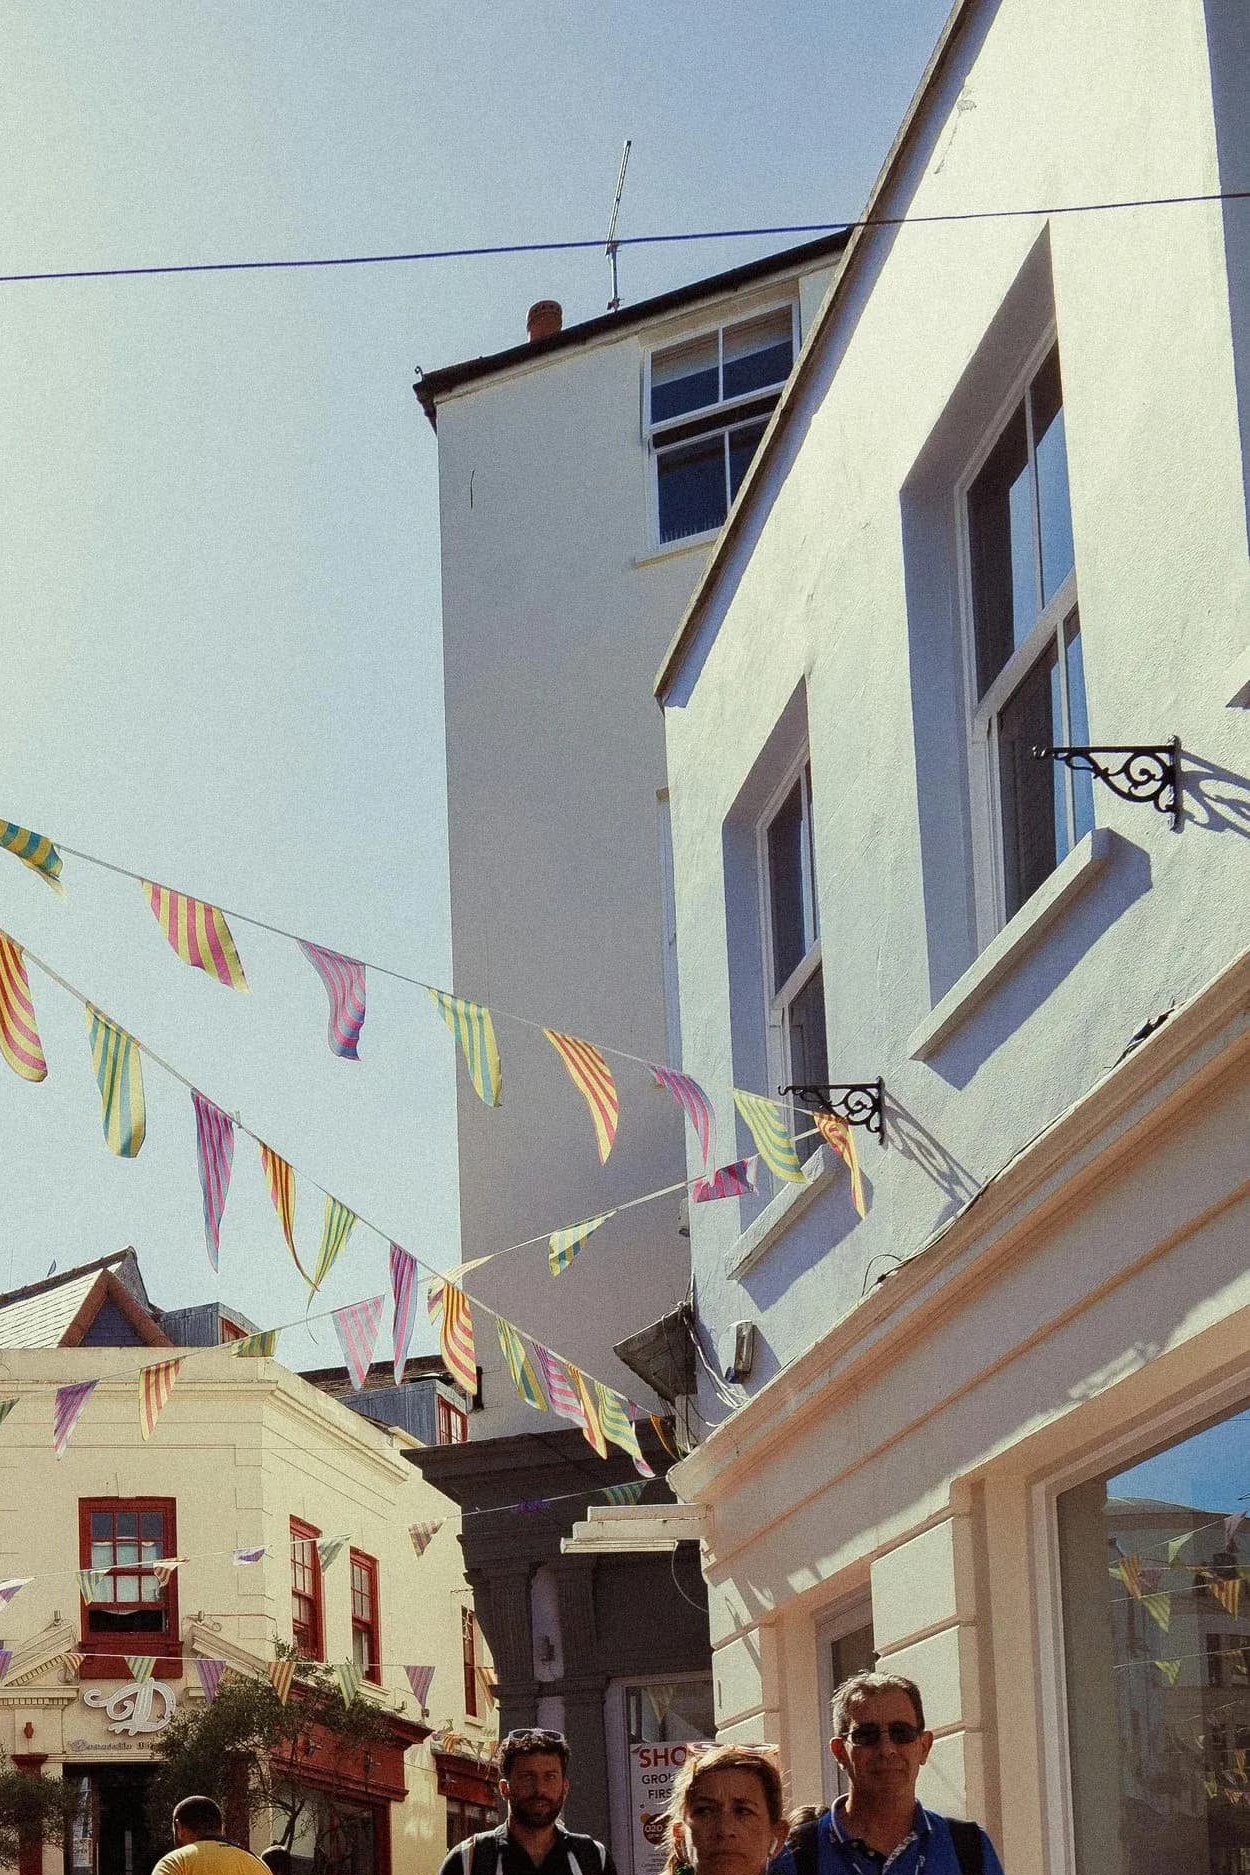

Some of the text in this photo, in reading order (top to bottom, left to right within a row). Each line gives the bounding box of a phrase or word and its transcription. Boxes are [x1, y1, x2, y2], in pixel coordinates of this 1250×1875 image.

[640, 1746, 687, 1769] SHO
[642, 1774, 675, 1785] GROU
[648, 1789, 672, 1799] FIRS
